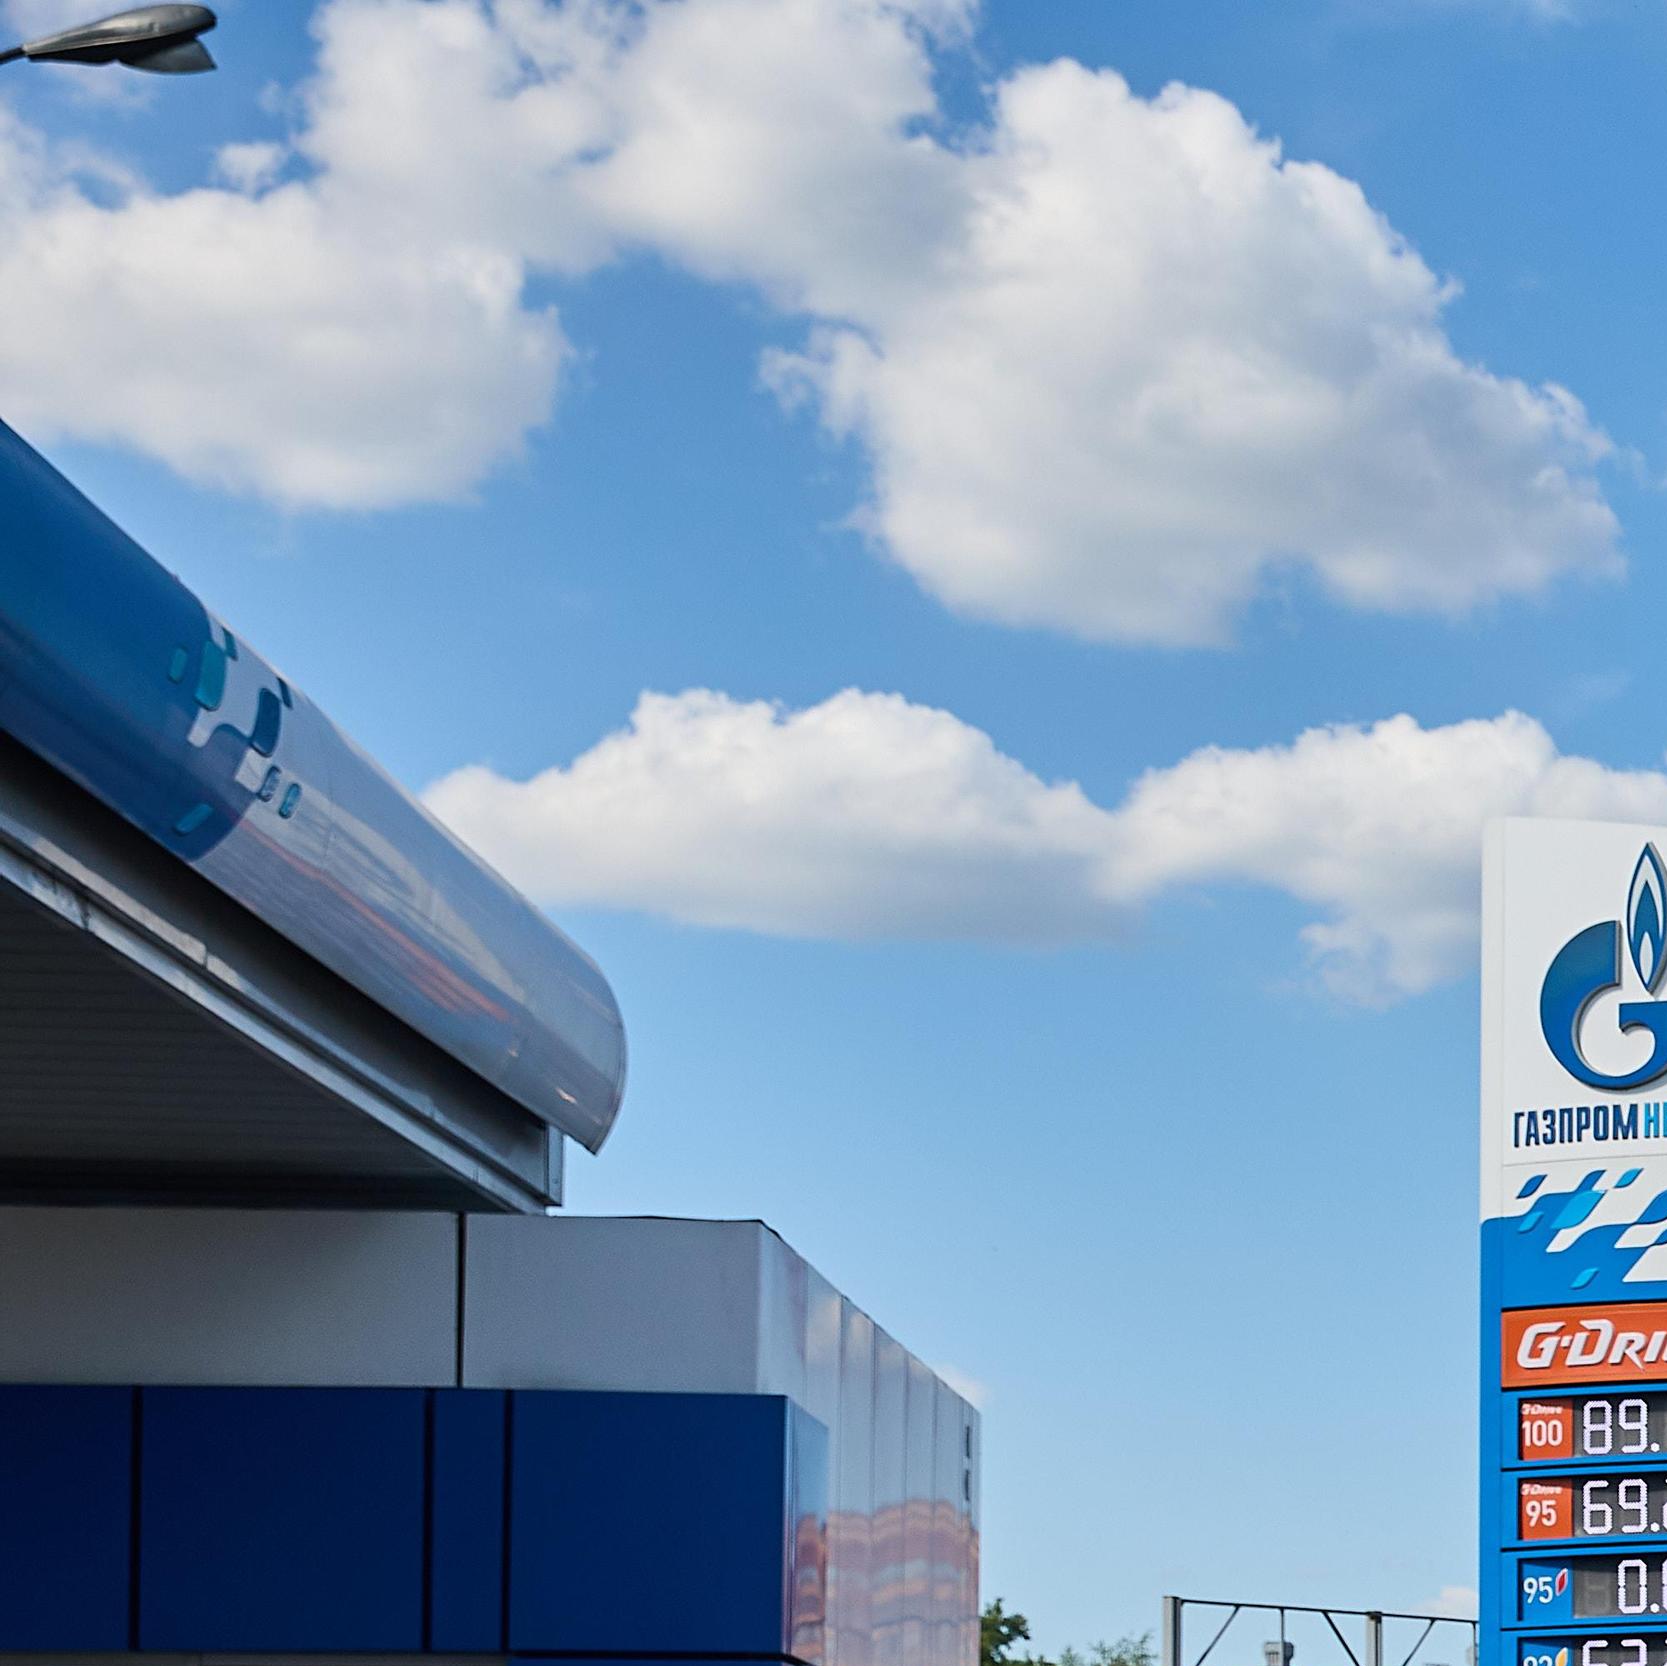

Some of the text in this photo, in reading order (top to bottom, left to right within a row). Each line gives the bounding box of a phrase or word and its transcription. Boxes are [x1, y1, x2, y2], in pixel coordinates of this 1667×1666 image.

[1513, 1104, 1639, 1148] ГАЗПРОМ
[1521, 1420, 1563, 1448] 100
[1526, 1500, 1557, 1527] 95
[1523, 1576, 1553, 1604] 95
